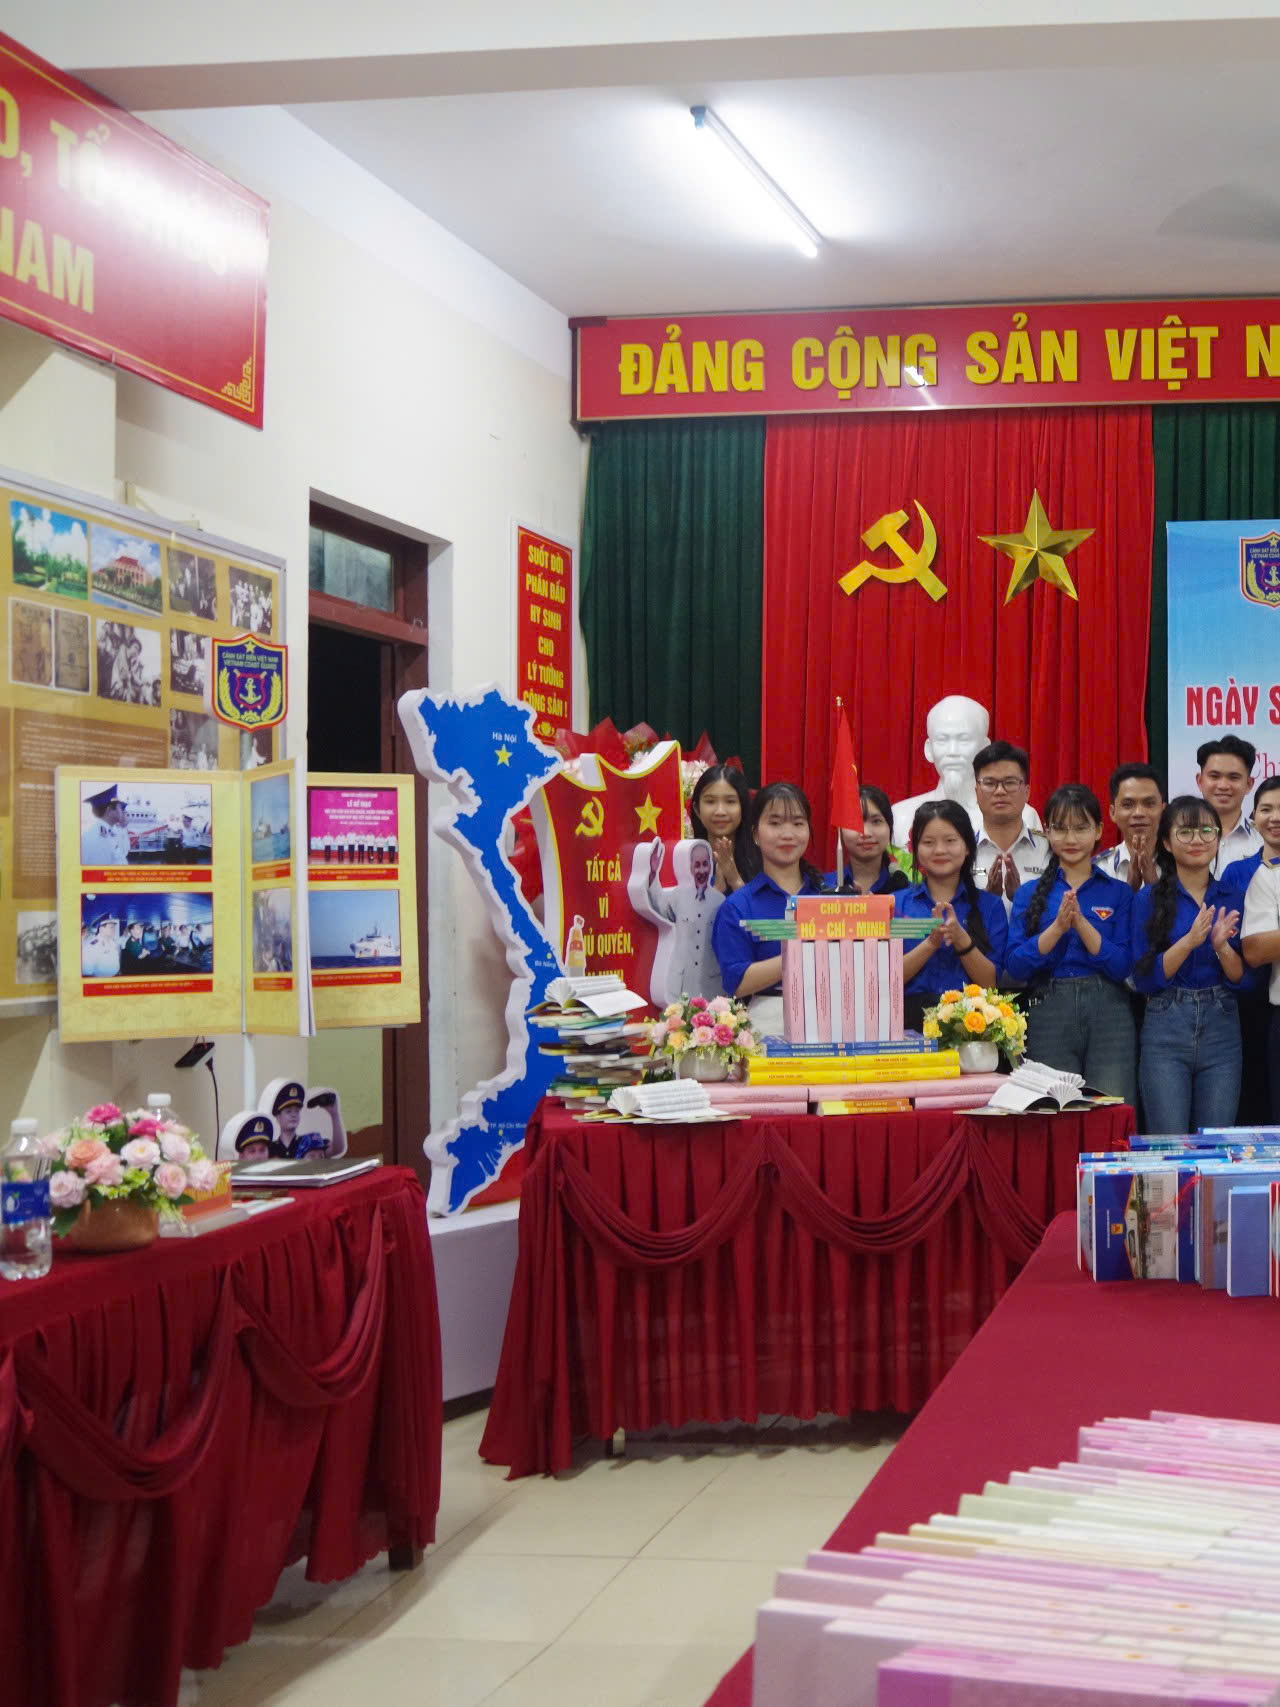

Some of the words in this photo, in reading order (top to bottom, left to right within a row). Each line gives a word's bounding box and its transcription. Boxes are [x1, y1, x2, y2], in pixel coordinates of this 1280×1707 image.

[619, 324, 764, 395] ĐẢNG
[791, 327, 938, 399] CỘNG
[966, 312, 1077, 385] SẢN
[1105, 316, 1218, 390] VIỆT
[528, 544, 549, 569] SUỐT
[530, 604, 541, 624] HY
[543, 609, 562, 632] SINH
[538, 636, 554, 657] CHO
[528, 660, 538, 682] LÝ
[1186, 678, 1259, 726] NGÀY
[586, 852, 606, 882] TẤT
[608, 852, 622, 882] CẢ
[599, 894, 609, 918] VÌ
[820, 899, 842, 915] CHỦ
[845, 902, 867, 917] TỊCH
[801, 917, 816, 938] HỒ
[827, 918, 846, 937] CHÍ
[856, 921, 886, 938] MINH
